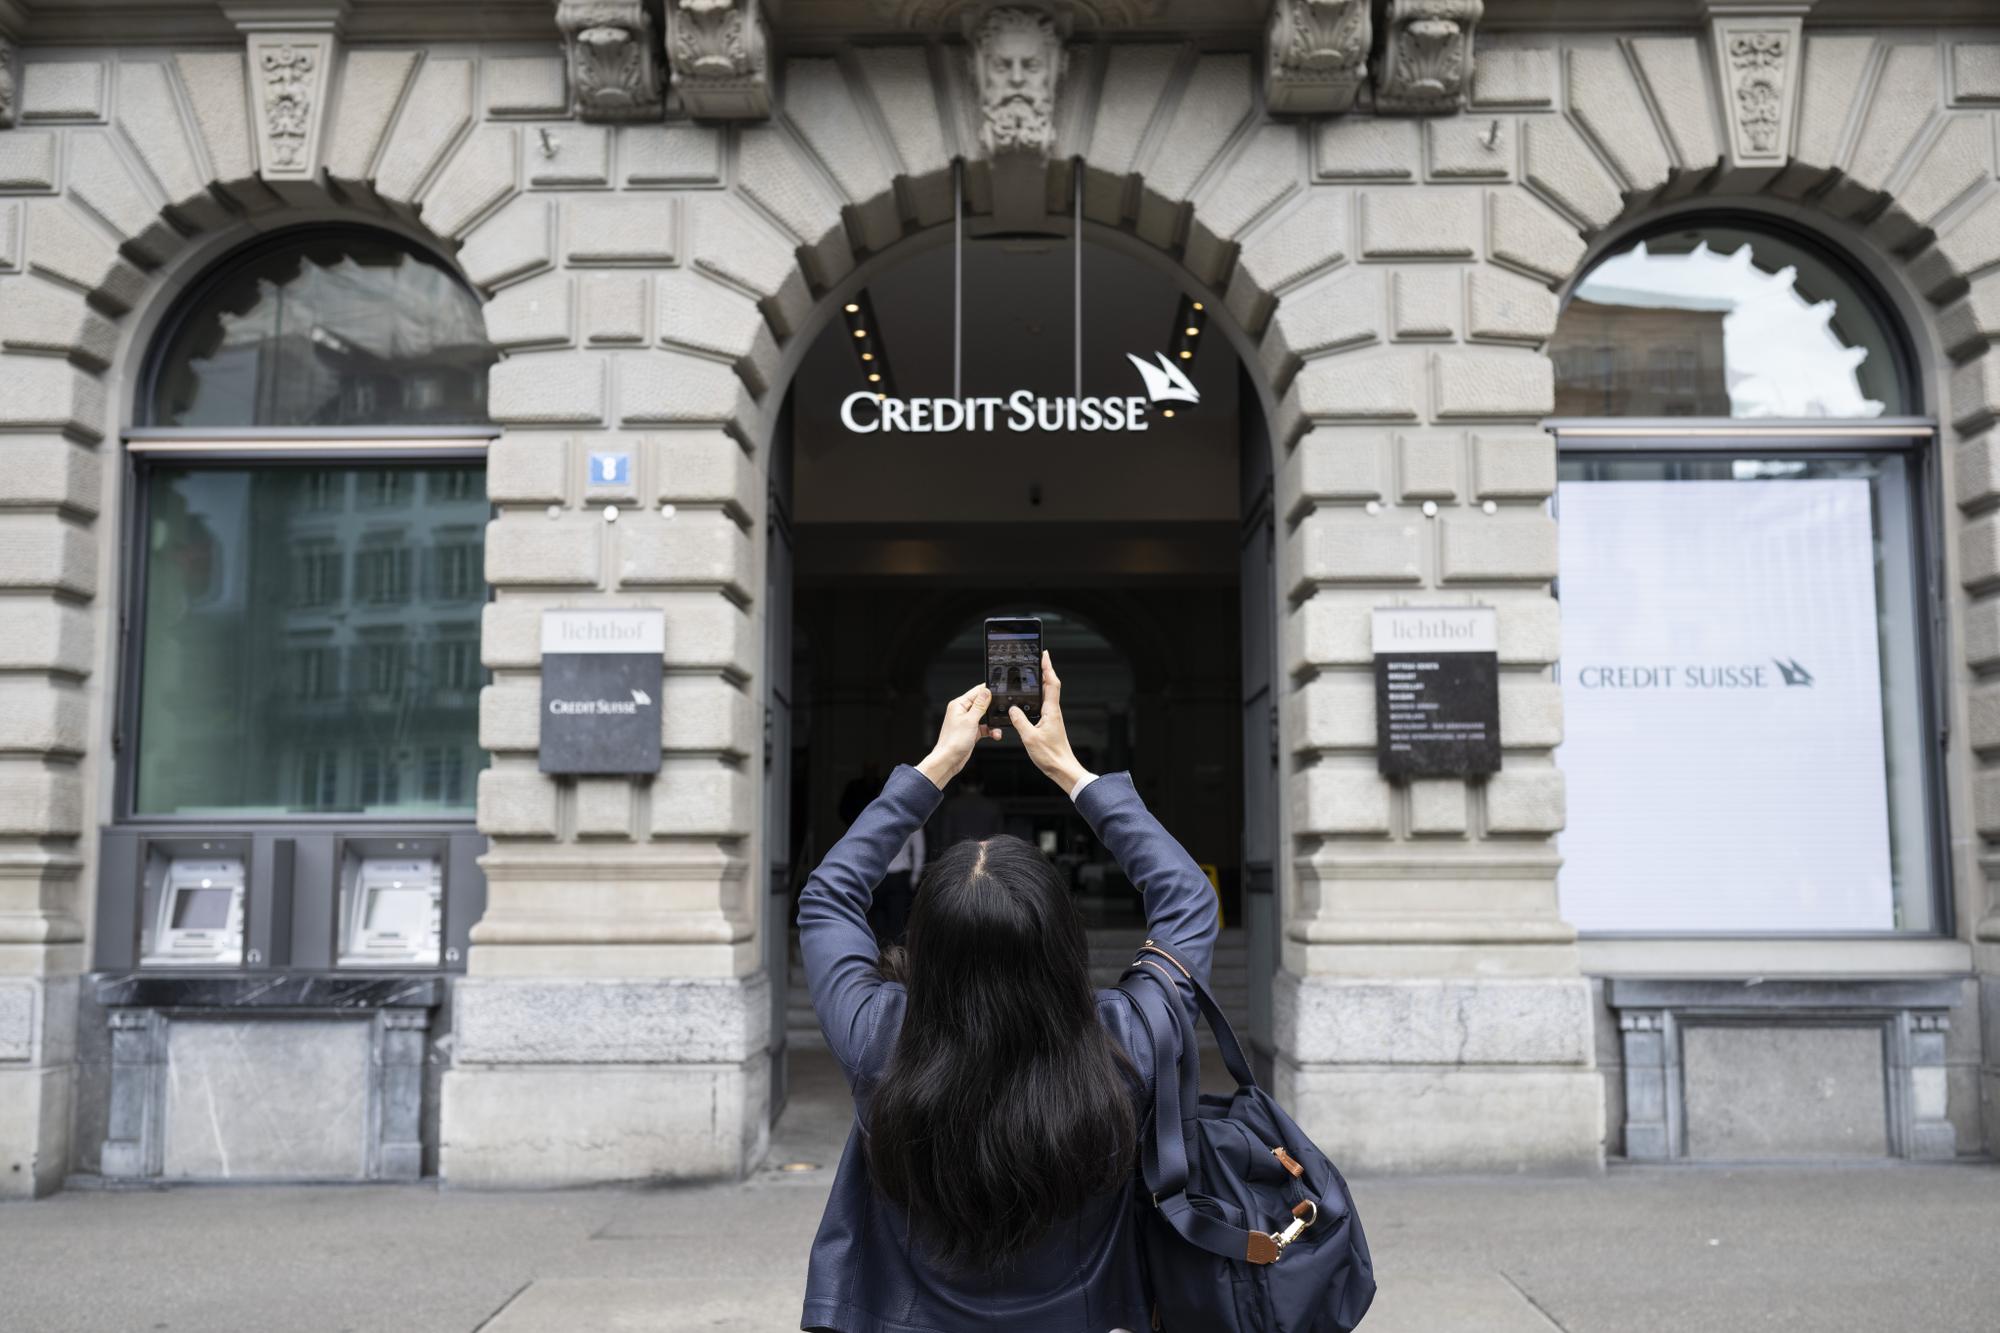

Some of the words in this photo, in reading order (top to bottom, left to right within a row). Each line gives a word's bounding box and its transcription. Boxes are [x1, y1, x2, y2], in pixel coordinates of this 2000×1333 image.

[841, 390, 1003, 433] CREDIT
[1007, 389, 1149, 432] SUISSE
[562, 620, 645, 640] lichthof
[1392, 618, 1476, 639] lichthof
[1579, 665, 1677, 688] CREDIT
[1685, 665, 1768, 688] SUISSE
